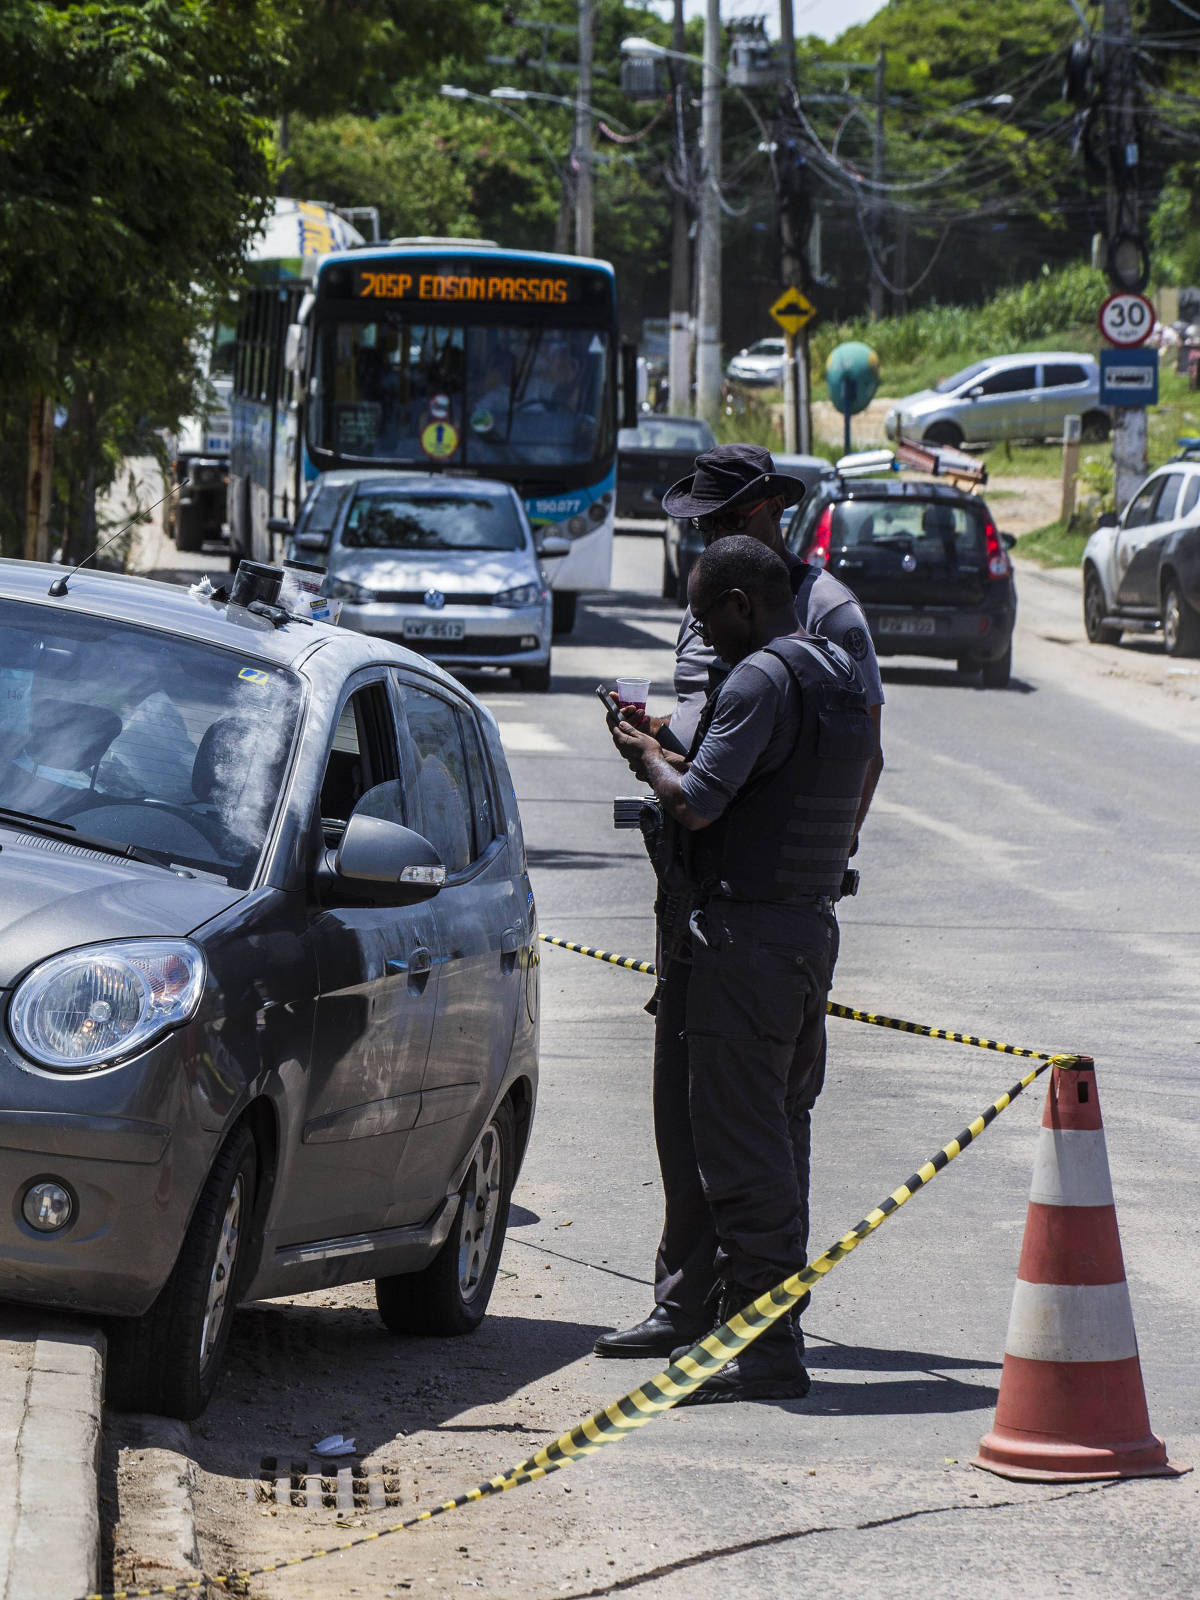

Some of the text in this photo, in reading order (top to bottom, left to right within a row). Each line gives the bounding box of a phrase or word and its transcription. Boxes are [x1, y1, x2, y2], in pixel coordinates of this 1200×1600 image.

[360, 272, 568, 302] 705P EDSON PASSOS
[1110, 302, 1145, 328] 30
